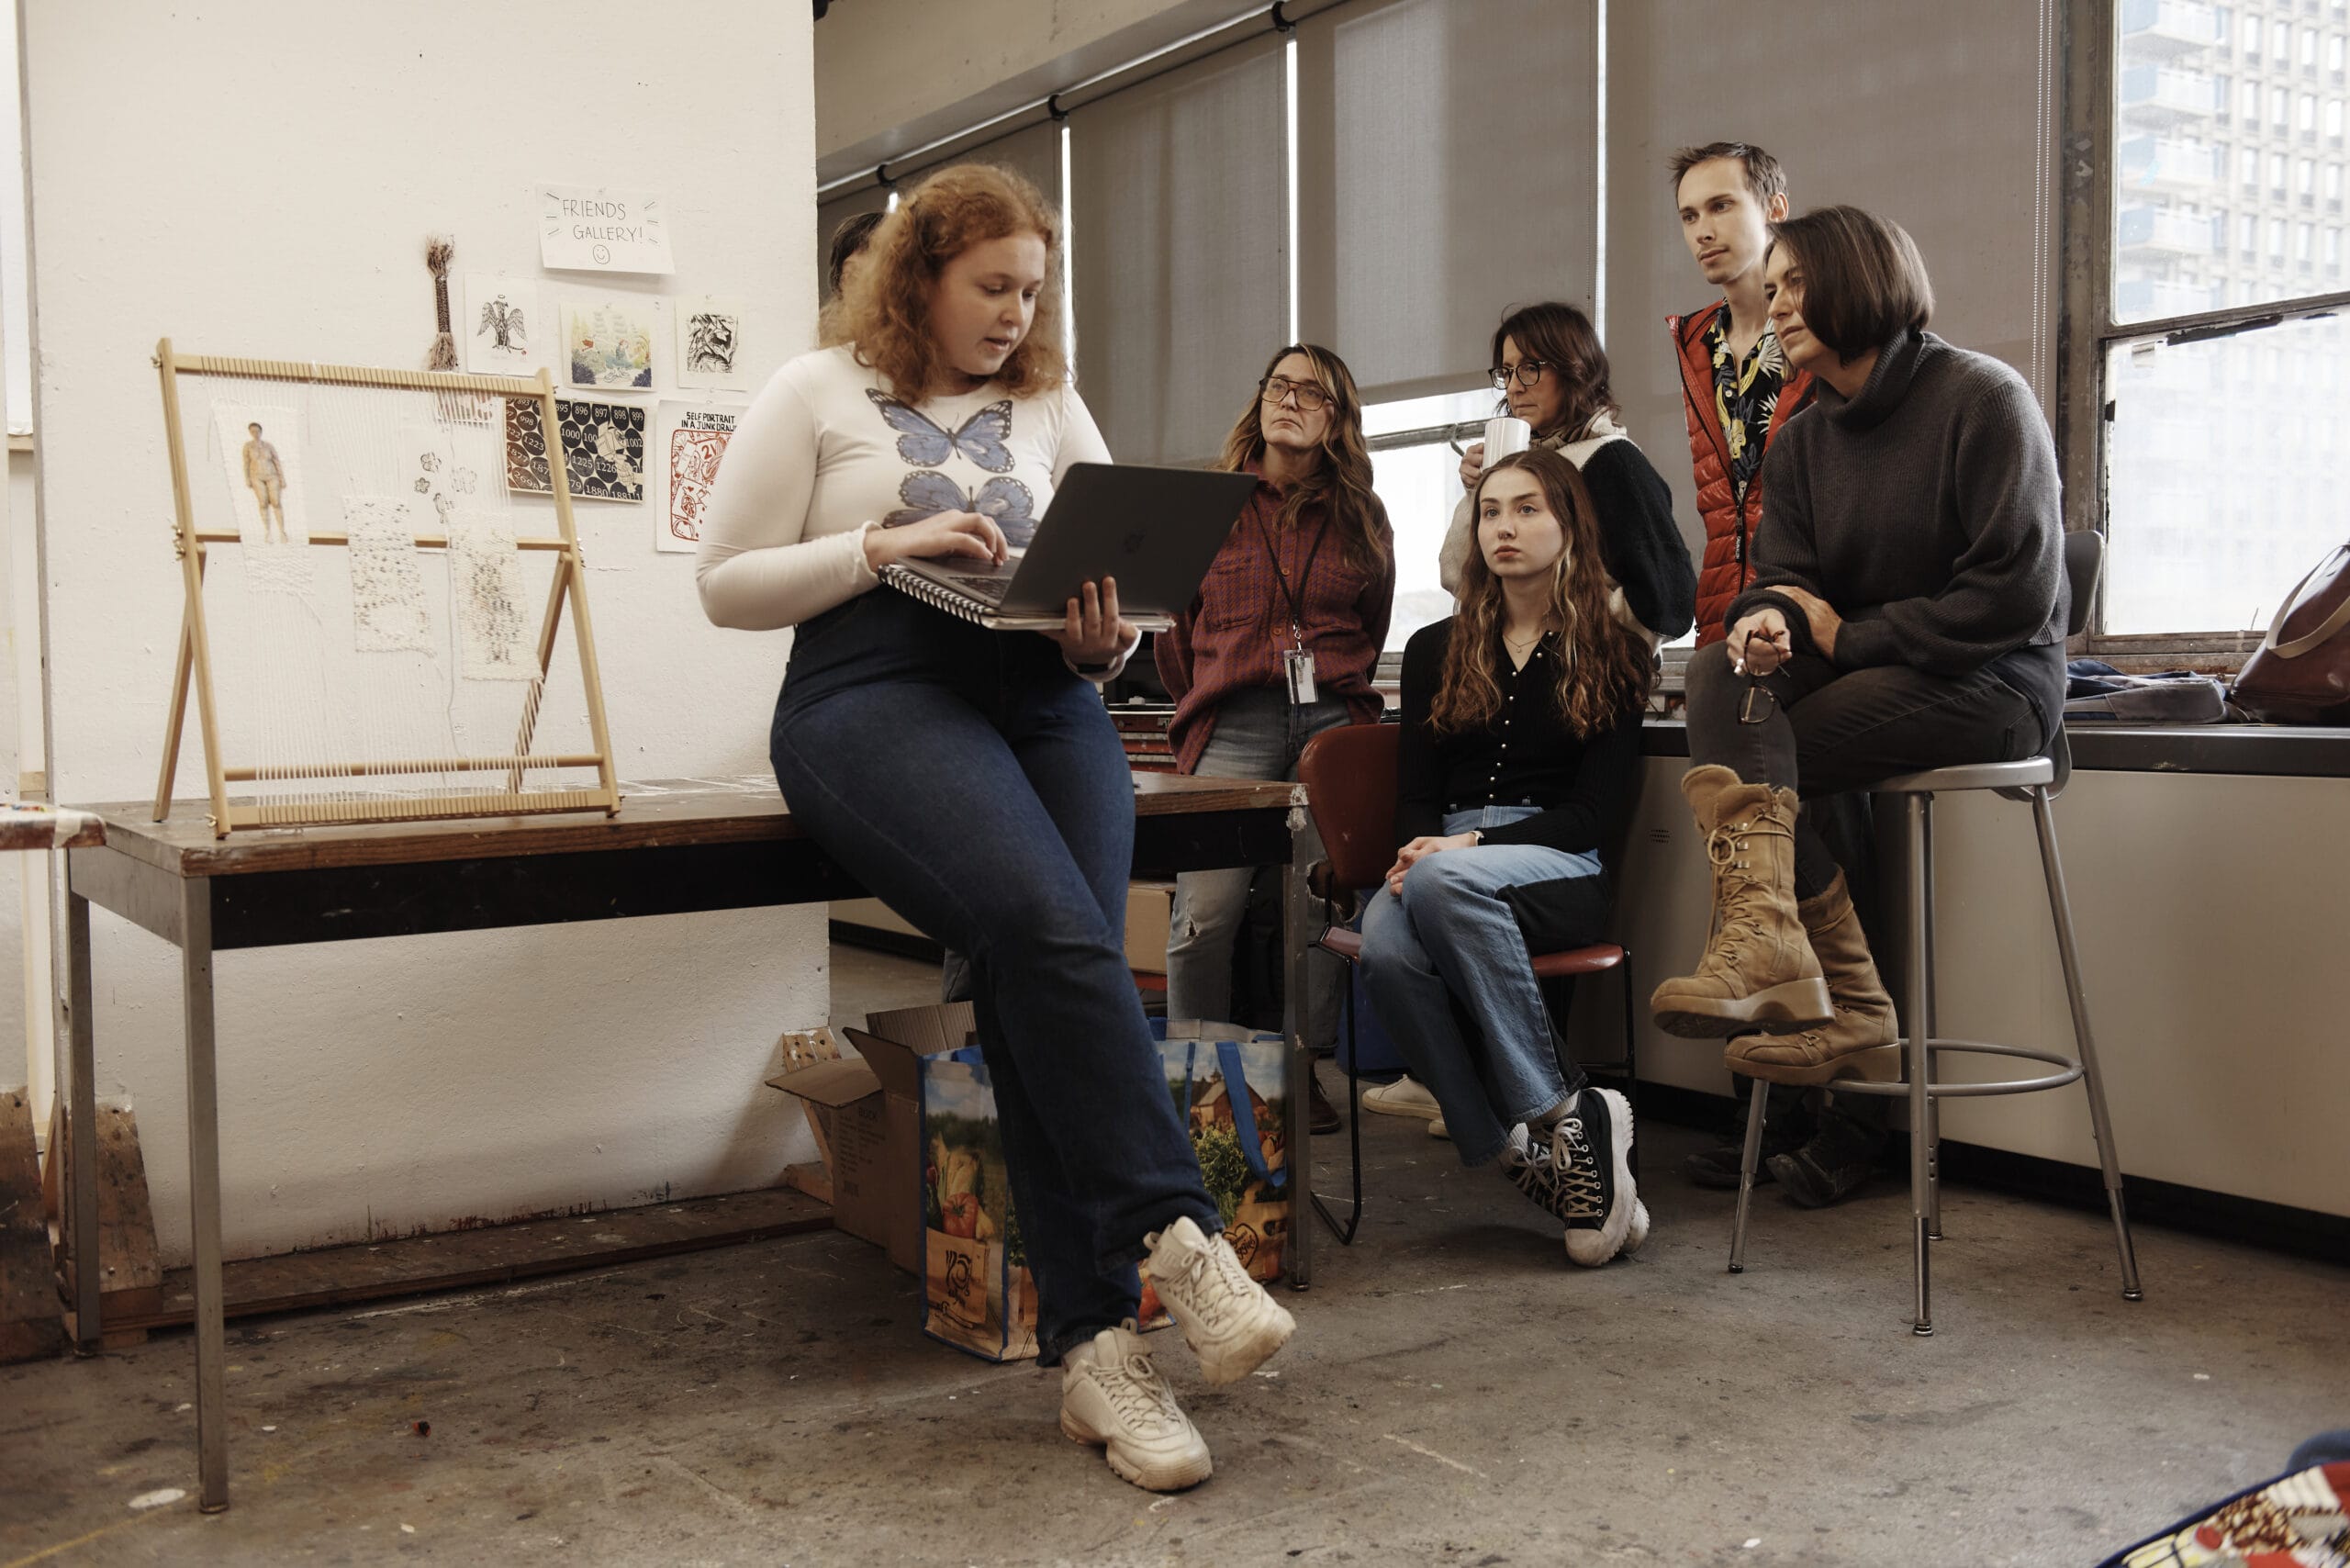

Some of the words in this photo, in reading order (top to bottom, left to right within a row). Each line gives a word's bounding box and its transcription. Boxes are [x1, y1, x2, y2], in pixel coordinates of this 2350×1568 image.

[562, 199, 627, 220] FRIENDS
[573, 224, 643, 244] GALLERY!
[575, 405, 588, 416] 896
[594, 408, 608, 418] 897
[613, 409, 627, 420] 898
[687, 412, 701, 420] SELF
[703, 413, 735, 423] PORTRAIT
[520, 415, 534, 426] 998
[561, 427, 581, 440] 1000
[583, 432, 598, 442] 100
[681, 420, 688, 428] IN
[690, 420, 696, 429] A
[697, 421, 715, 430] JUNK
[524, 435, 544, 451] 1223
[572, 454, 593, 469] 1225
[596, 461, 617, 474] 1226
[532, 461, 549, 476] 187
[569, 478, 582, 490] 79
